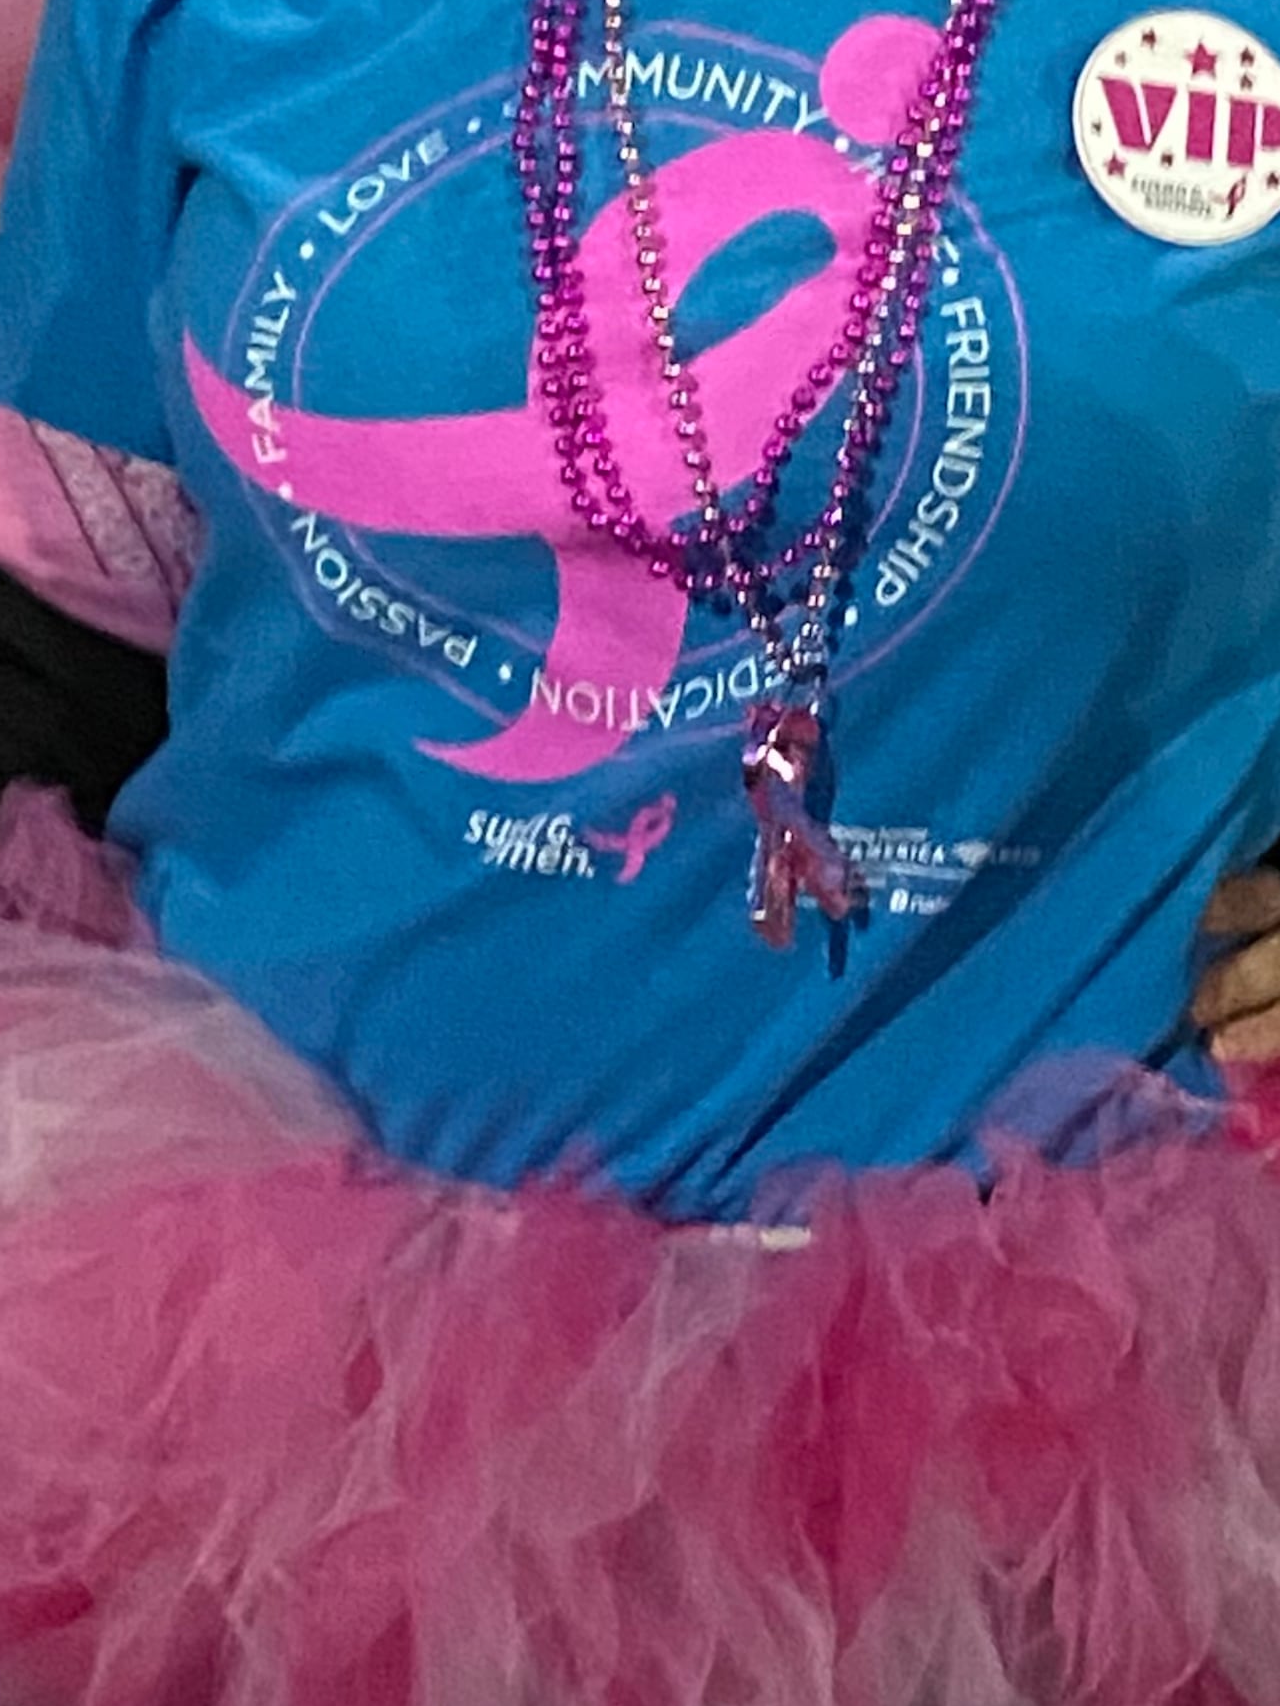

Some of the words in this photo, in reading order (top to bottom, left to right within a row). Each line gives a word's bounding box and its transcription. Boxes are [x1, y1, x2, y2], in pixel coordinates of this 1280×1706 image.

[317, 128, 450, 236] LOVE
[243, 270, 298, 465] FAMILY
[874, 295, 992, 607] FRIENDSHIP
[290, 509, 479, 669] PASSION
